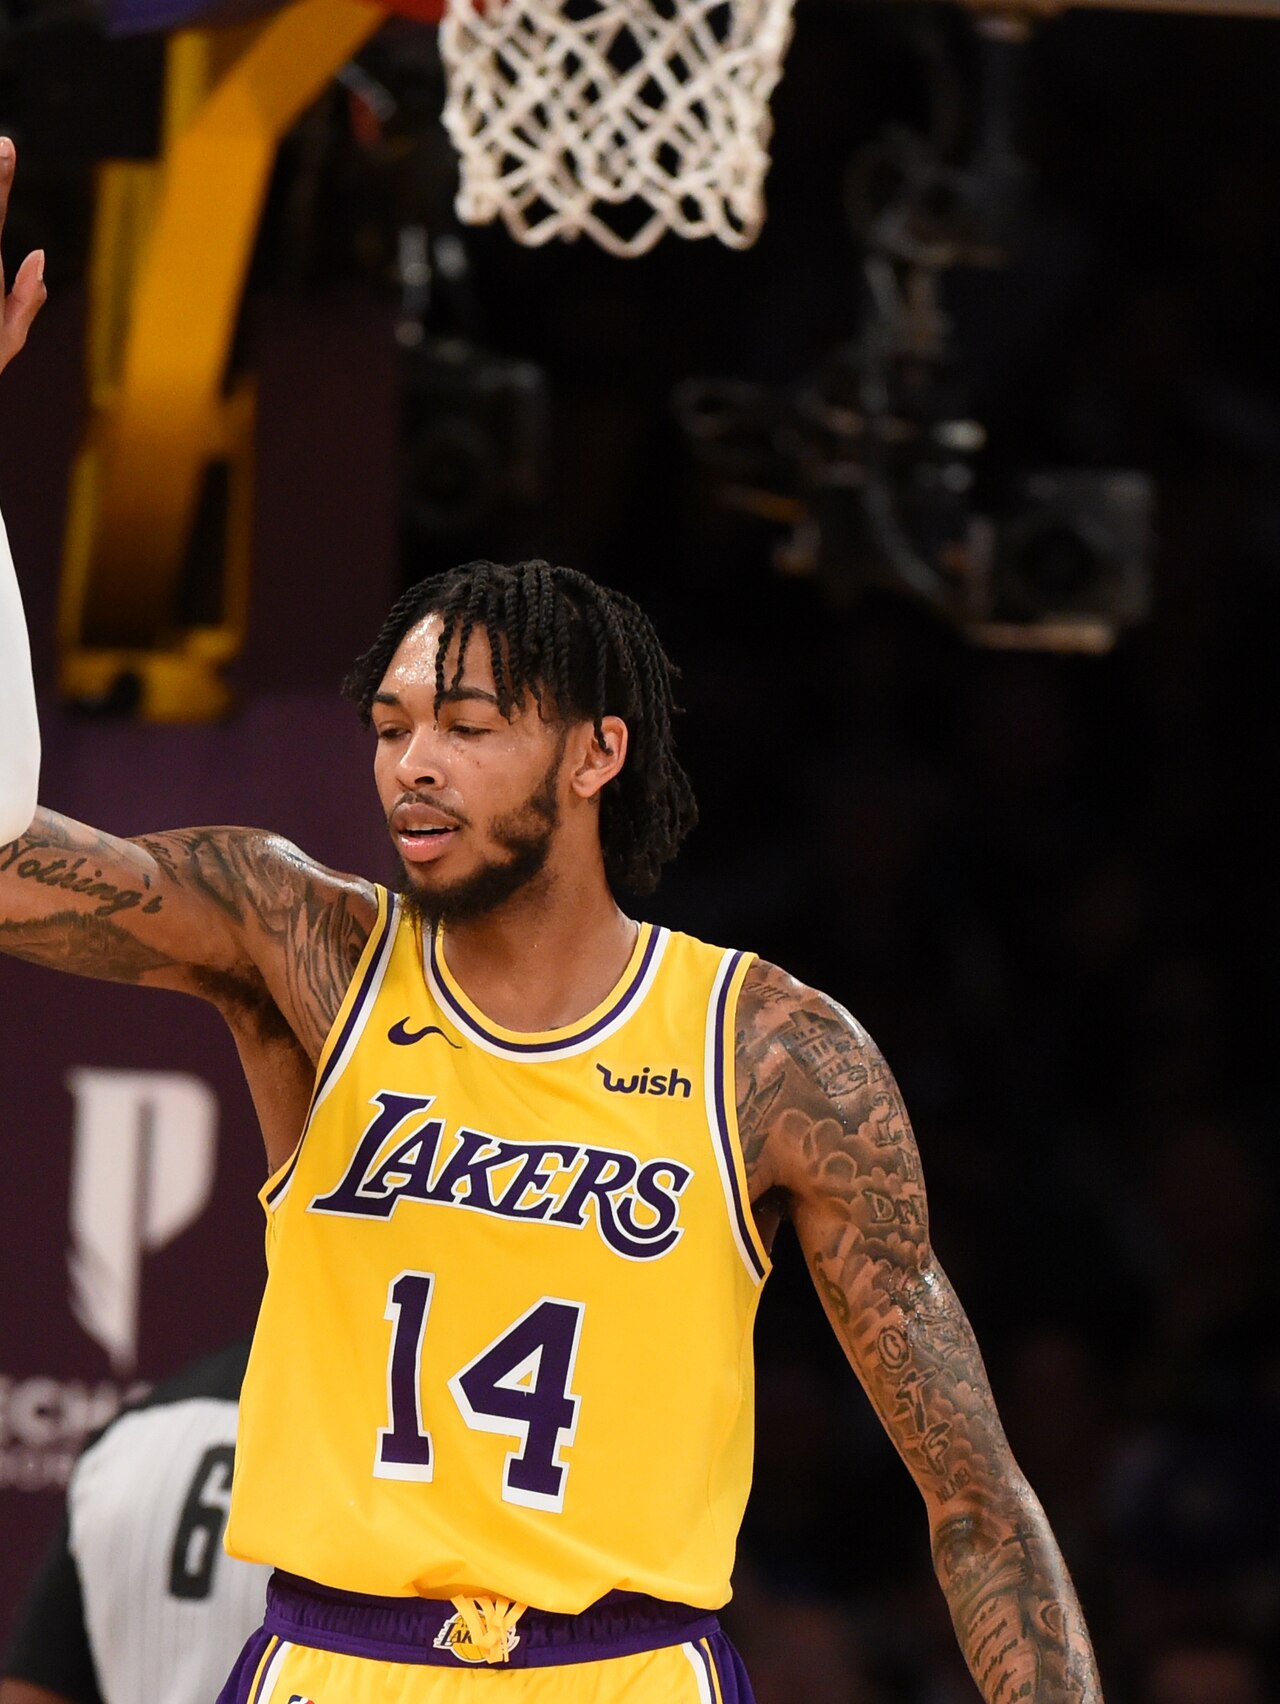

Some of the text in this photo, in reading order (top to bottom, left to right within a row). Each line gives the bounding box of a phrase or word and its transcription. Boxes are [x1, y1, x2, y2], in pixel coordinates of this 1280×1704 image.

[596, 1063, 691, 1098] wish
[306, 1090, 694, 1262] LAKERS
[372, 1269, 586, 1513] 14
[169, 1443, 234, 1602] 6
